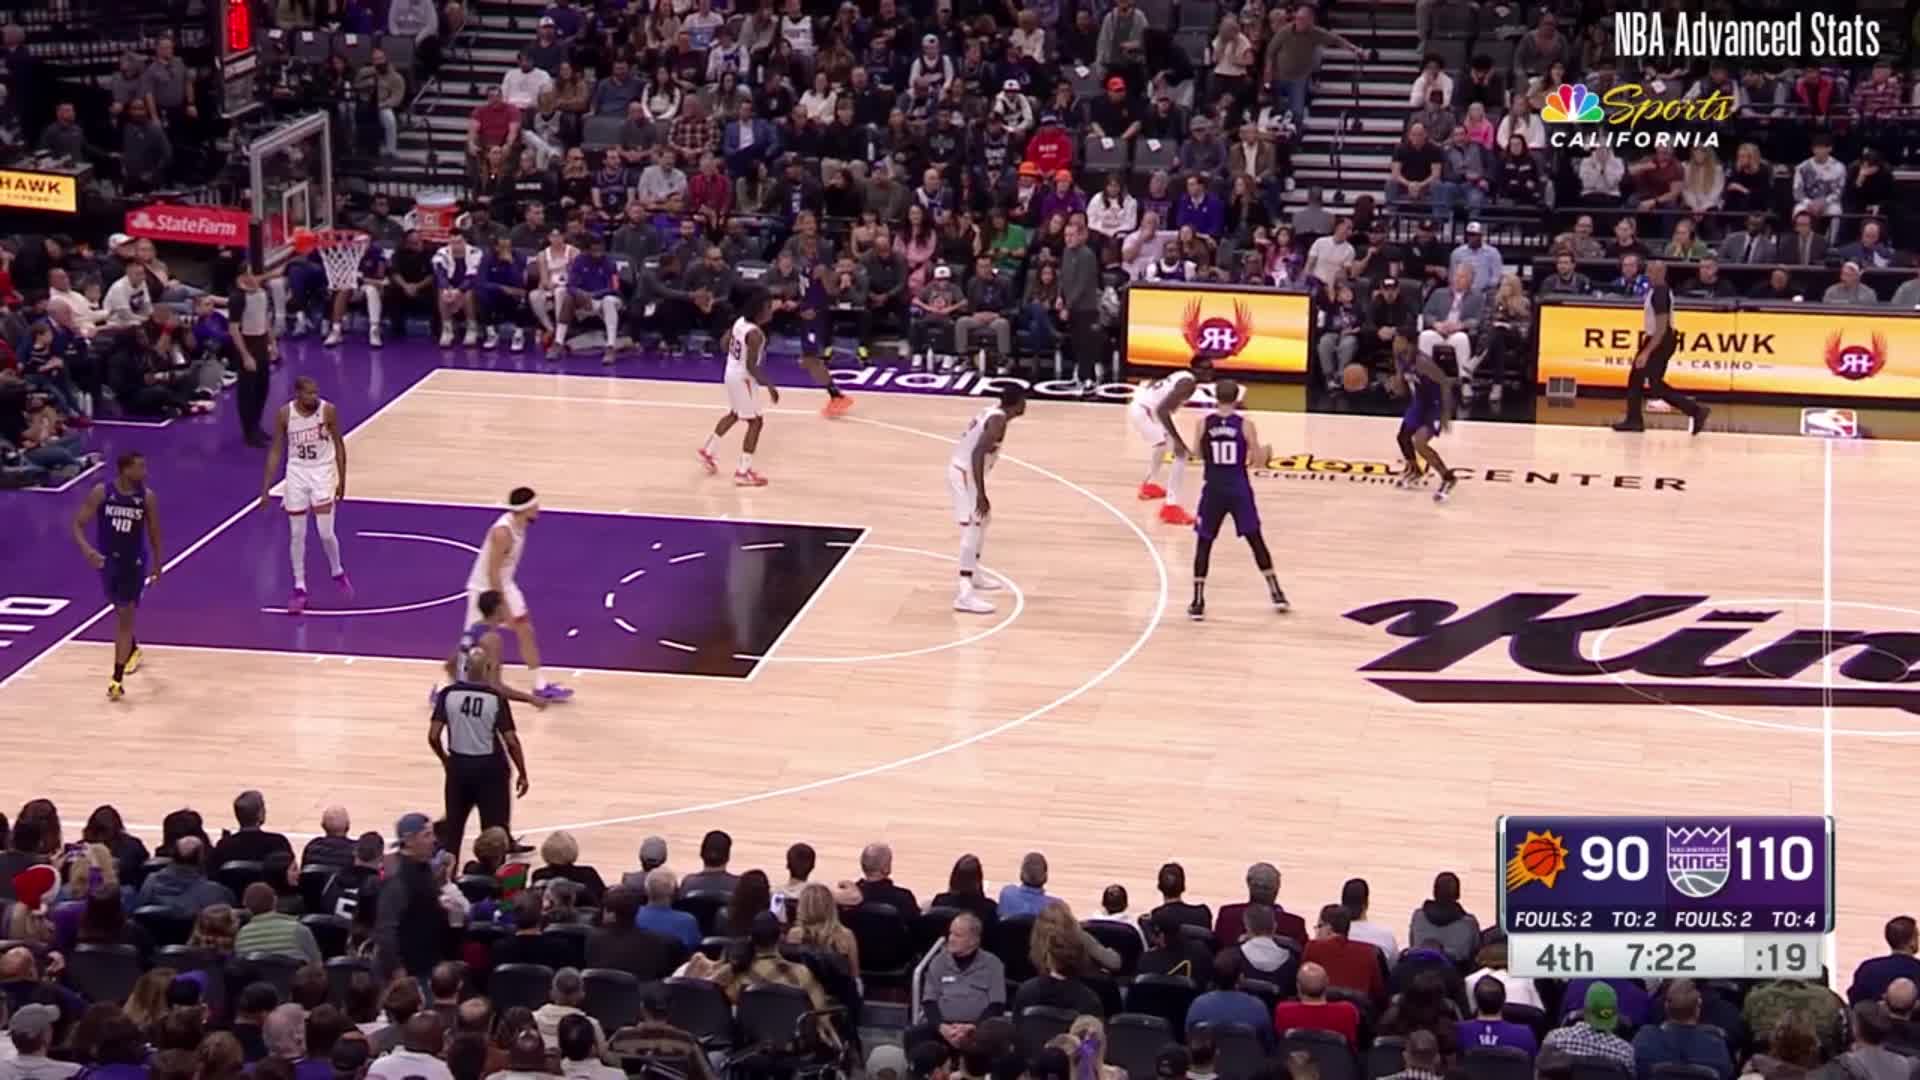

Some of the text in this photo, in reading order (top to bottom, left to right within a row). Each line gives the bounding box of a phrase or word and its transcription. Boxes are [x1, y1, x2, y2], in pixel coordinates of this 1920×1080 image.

[1690, 360, 1753, 370] CASINO
[297, 443, 317, 460] 35
[1210, 440, 1238, 465] 10
[105, 503, 144, 521] KINGS
[112, 517, 133, 533] 40
[461, 695, 484, 718] 40
